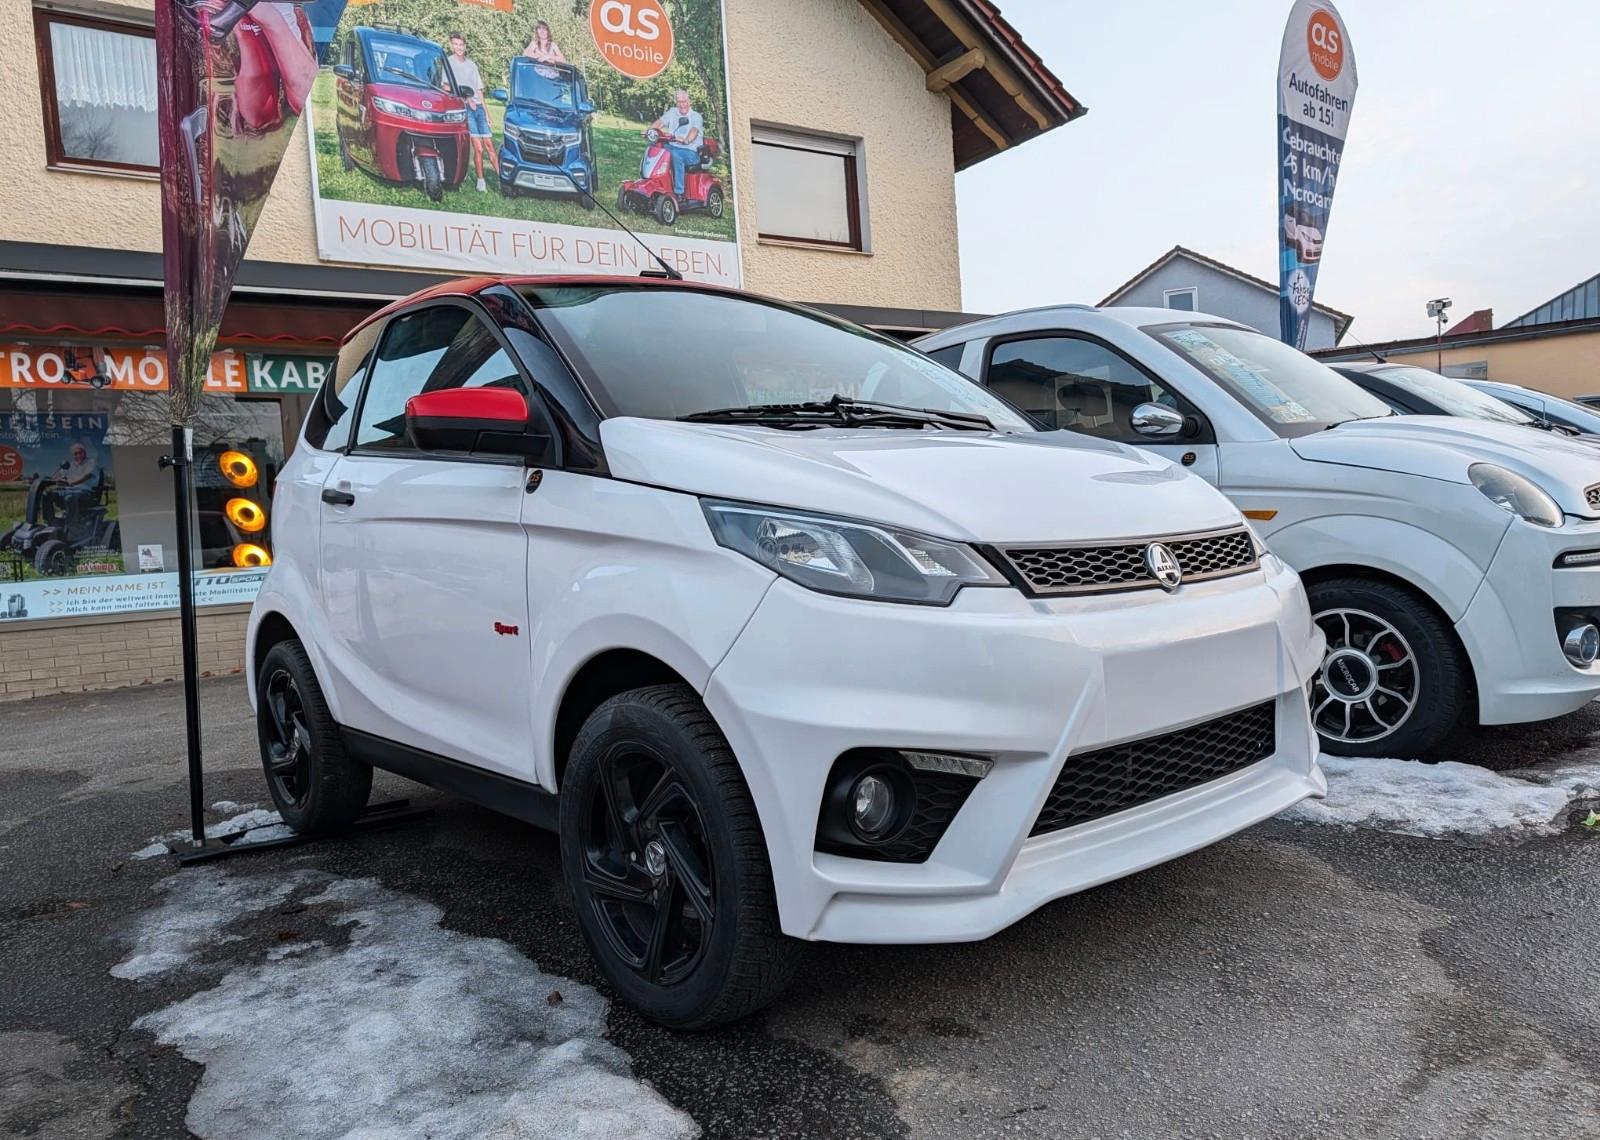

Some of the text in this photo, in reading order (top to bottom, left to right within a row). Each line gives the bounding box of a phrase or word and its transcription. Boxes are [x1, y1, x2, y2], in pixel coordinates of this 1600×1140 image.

[600, 0, 660, 40] as
[1311, 22, 1338, 54] as
[604, 42, 664, 64] mobile
[1311, 51, 1339, 72] mobile
[1289, 72, 1348, 112] Autofahren
[1303, 101, 1334, 127] ab 15!
[1303, 158, 1335, 187] km/h
[339, 215, 503, 256] MOBILITÄT
[512, 230, 567, 263] FÜR
[576, 239, 638, 268] DEIN
[103, 354, 242, 388] MOLE
[252, 360, 333, 389] KAB
[46, 416, 102, 429] SEIN
[67, 585, 101, 595] MEIN
[105, 582, 143, 593] NAME
[147, 580, 167, 590] IST
[1336, 658, 1360, 693] MICROCAR
